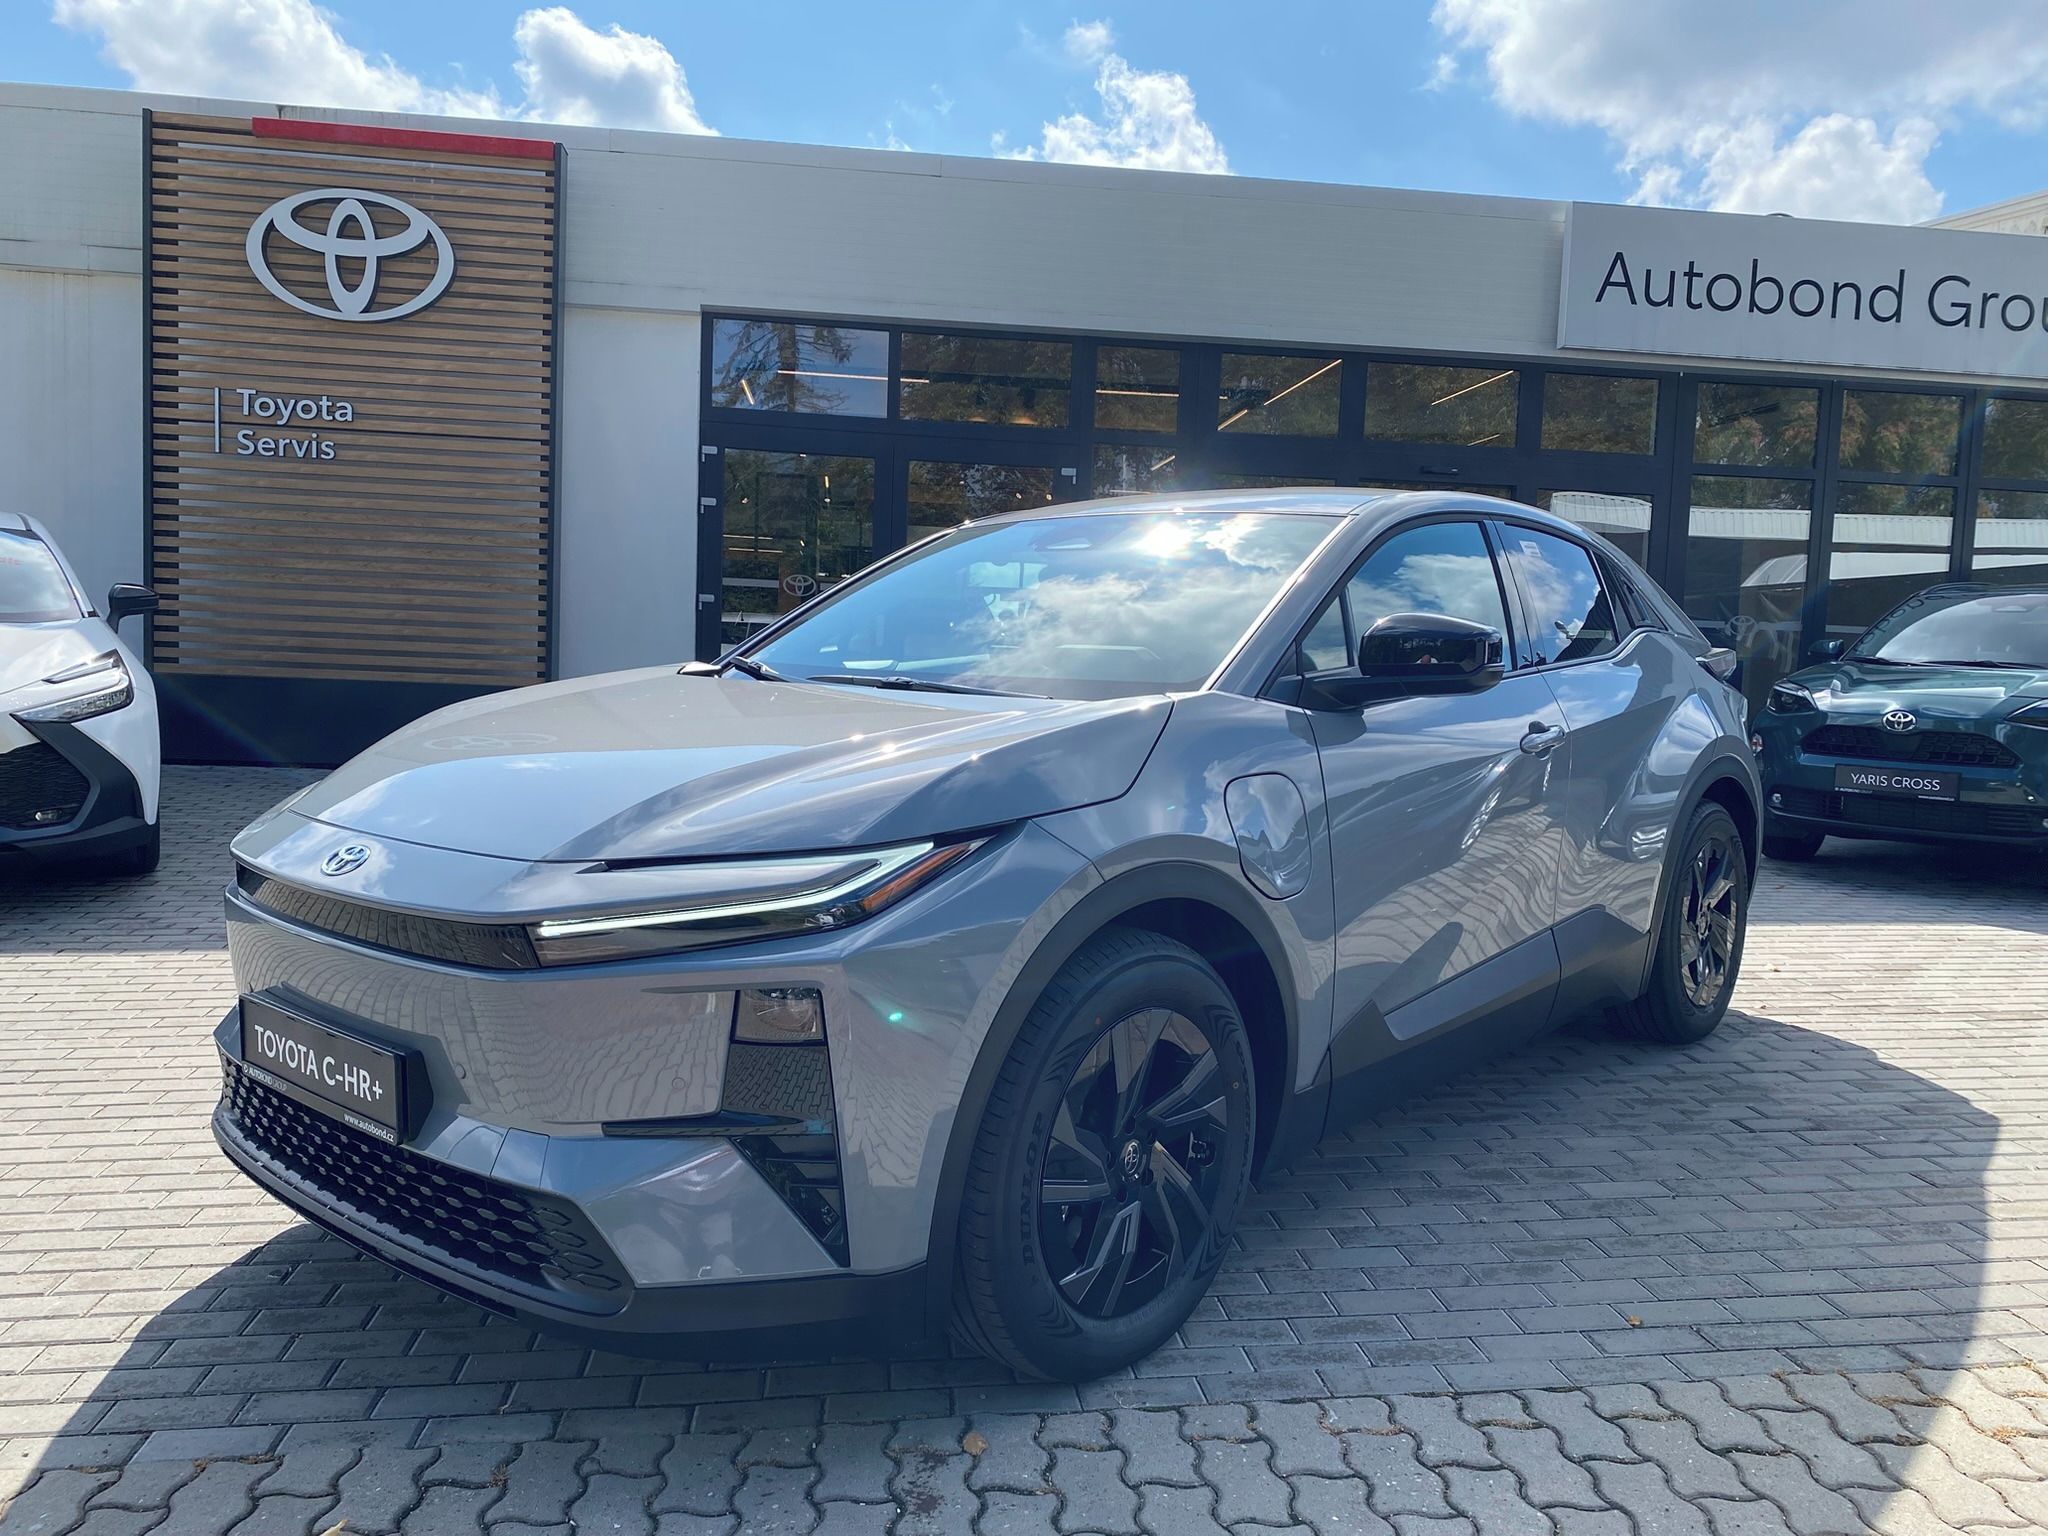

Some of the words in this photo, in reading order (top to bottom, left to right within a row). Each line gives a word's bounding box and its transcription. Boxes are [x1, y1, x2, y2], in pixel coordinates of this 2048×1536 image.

[1594, 251, 1905, 324] Autobond
[1927, 274, 2048, 333] Gro
[236, 388, 354, 426] Toyota
[237, 429, 337, 461] Servis
[1850, 772, 1888, 787] YARIS
[1891, 776, 1941, 791] CROSS
[254, 1024, 319, 1080] TOYOTA
[322, 1055, 383, 1102] C-HR+
[343, 1112, 394, 1143] www.autobond.cz
[1020, 1111, 1043, 1266] DUNLOP
